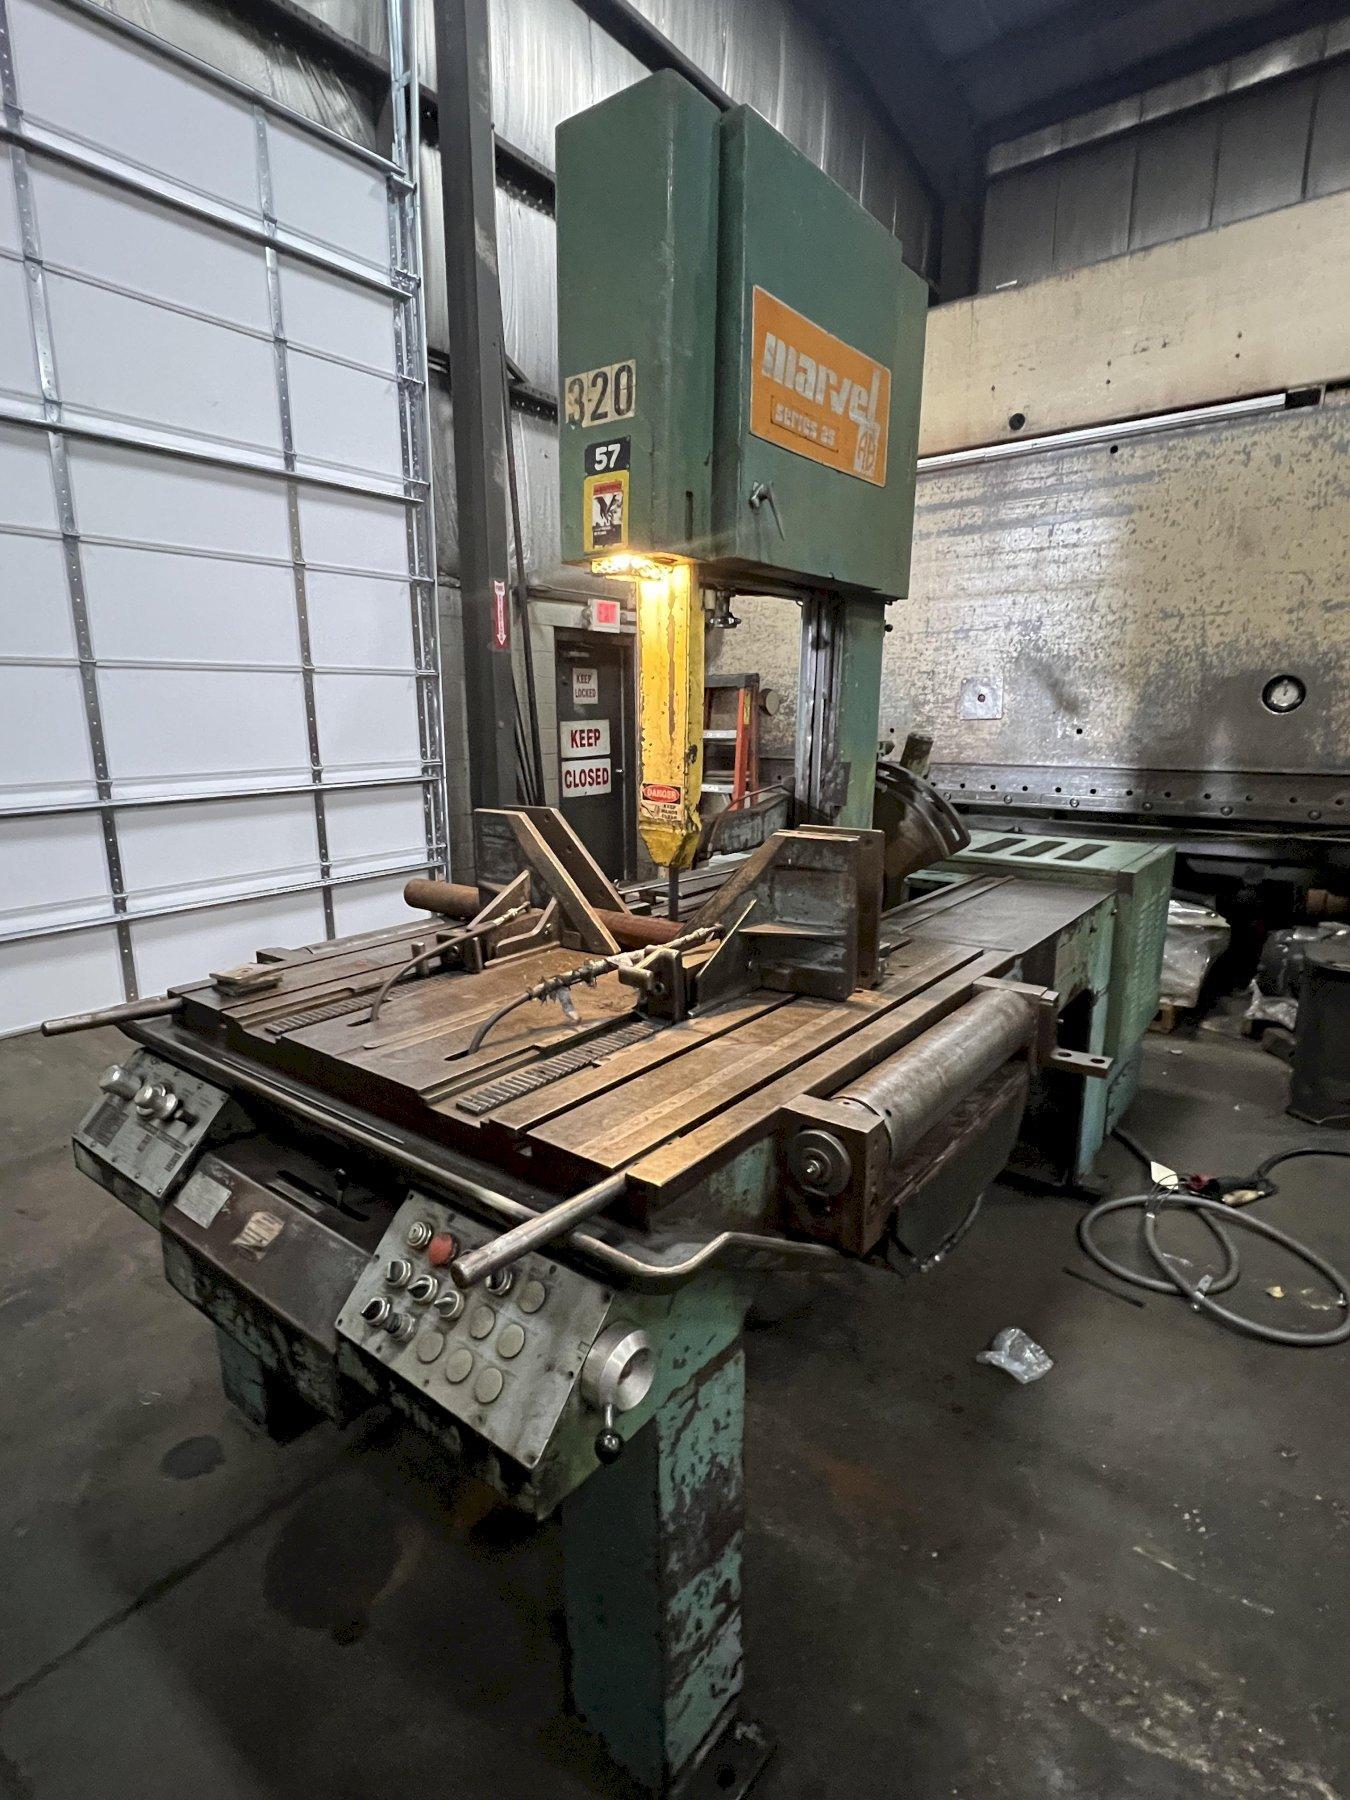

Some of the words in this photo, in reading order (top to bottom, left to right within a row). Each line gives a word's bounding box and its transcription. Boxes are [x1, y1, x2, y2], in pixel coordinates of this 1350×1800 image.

[567, 364, 633, 422] 320
[594, 443, 621, 471] 57
[576, 673, 592, 684] KEEP
[575, 688, 596, 698] LOCKED
[570, 728, 601, 749] KEEP
[564, 767, 609, 789] CLOSED
[646, 788, 677, 799] DANGER
